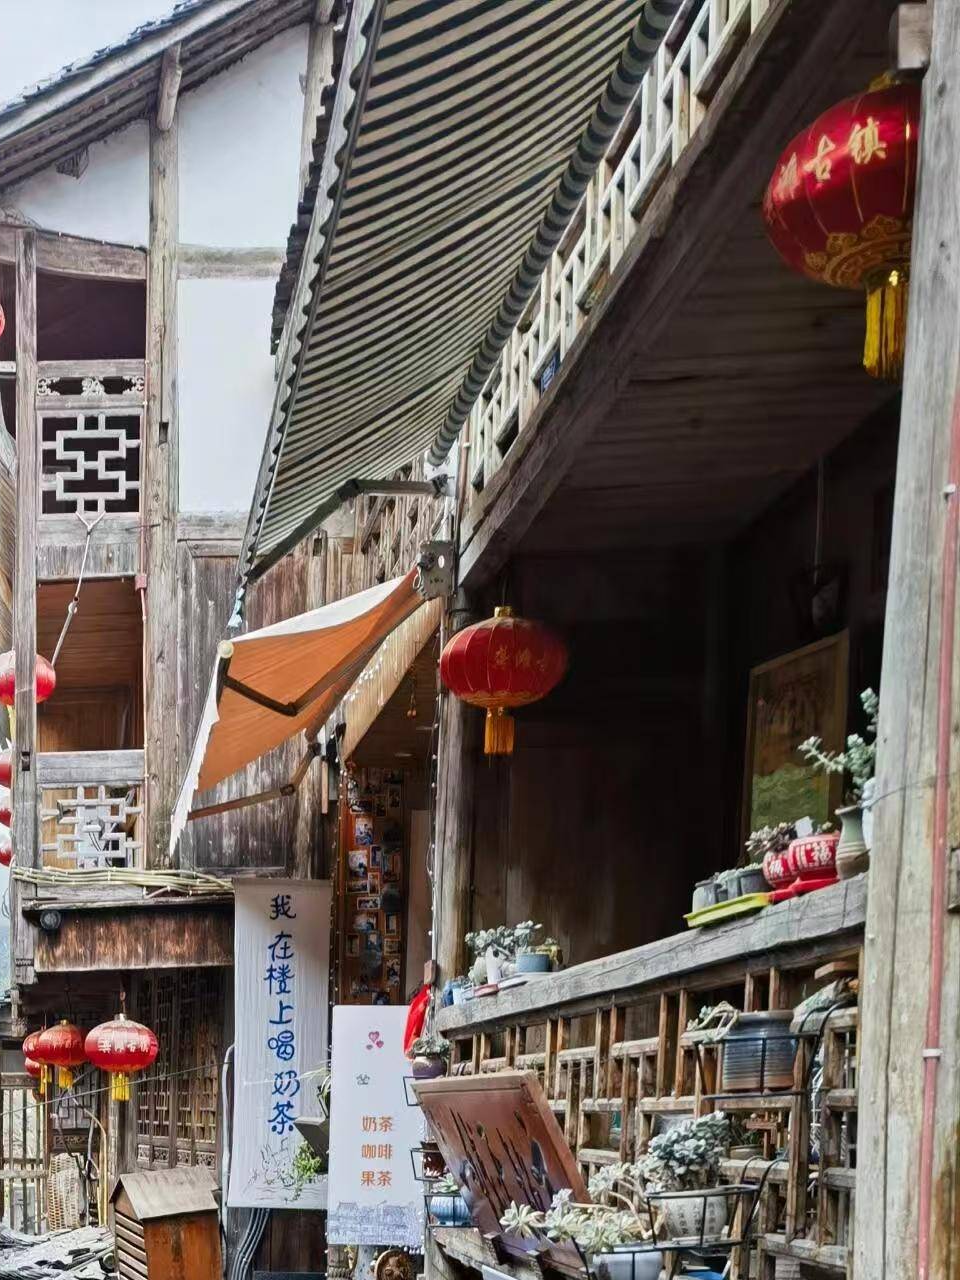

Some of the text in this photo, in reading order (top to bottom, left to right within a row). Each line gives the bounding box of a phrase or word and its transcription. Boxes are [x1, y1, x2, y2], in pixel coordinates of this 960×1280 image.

[263, 893, 300, 1135] 我在楼上喝奶茶
[361, 1115, 395, 1133] 奶茶
[360, 1143, 393, 1160] 咖啡
[360, 1170, 392, 1188] 果茶
